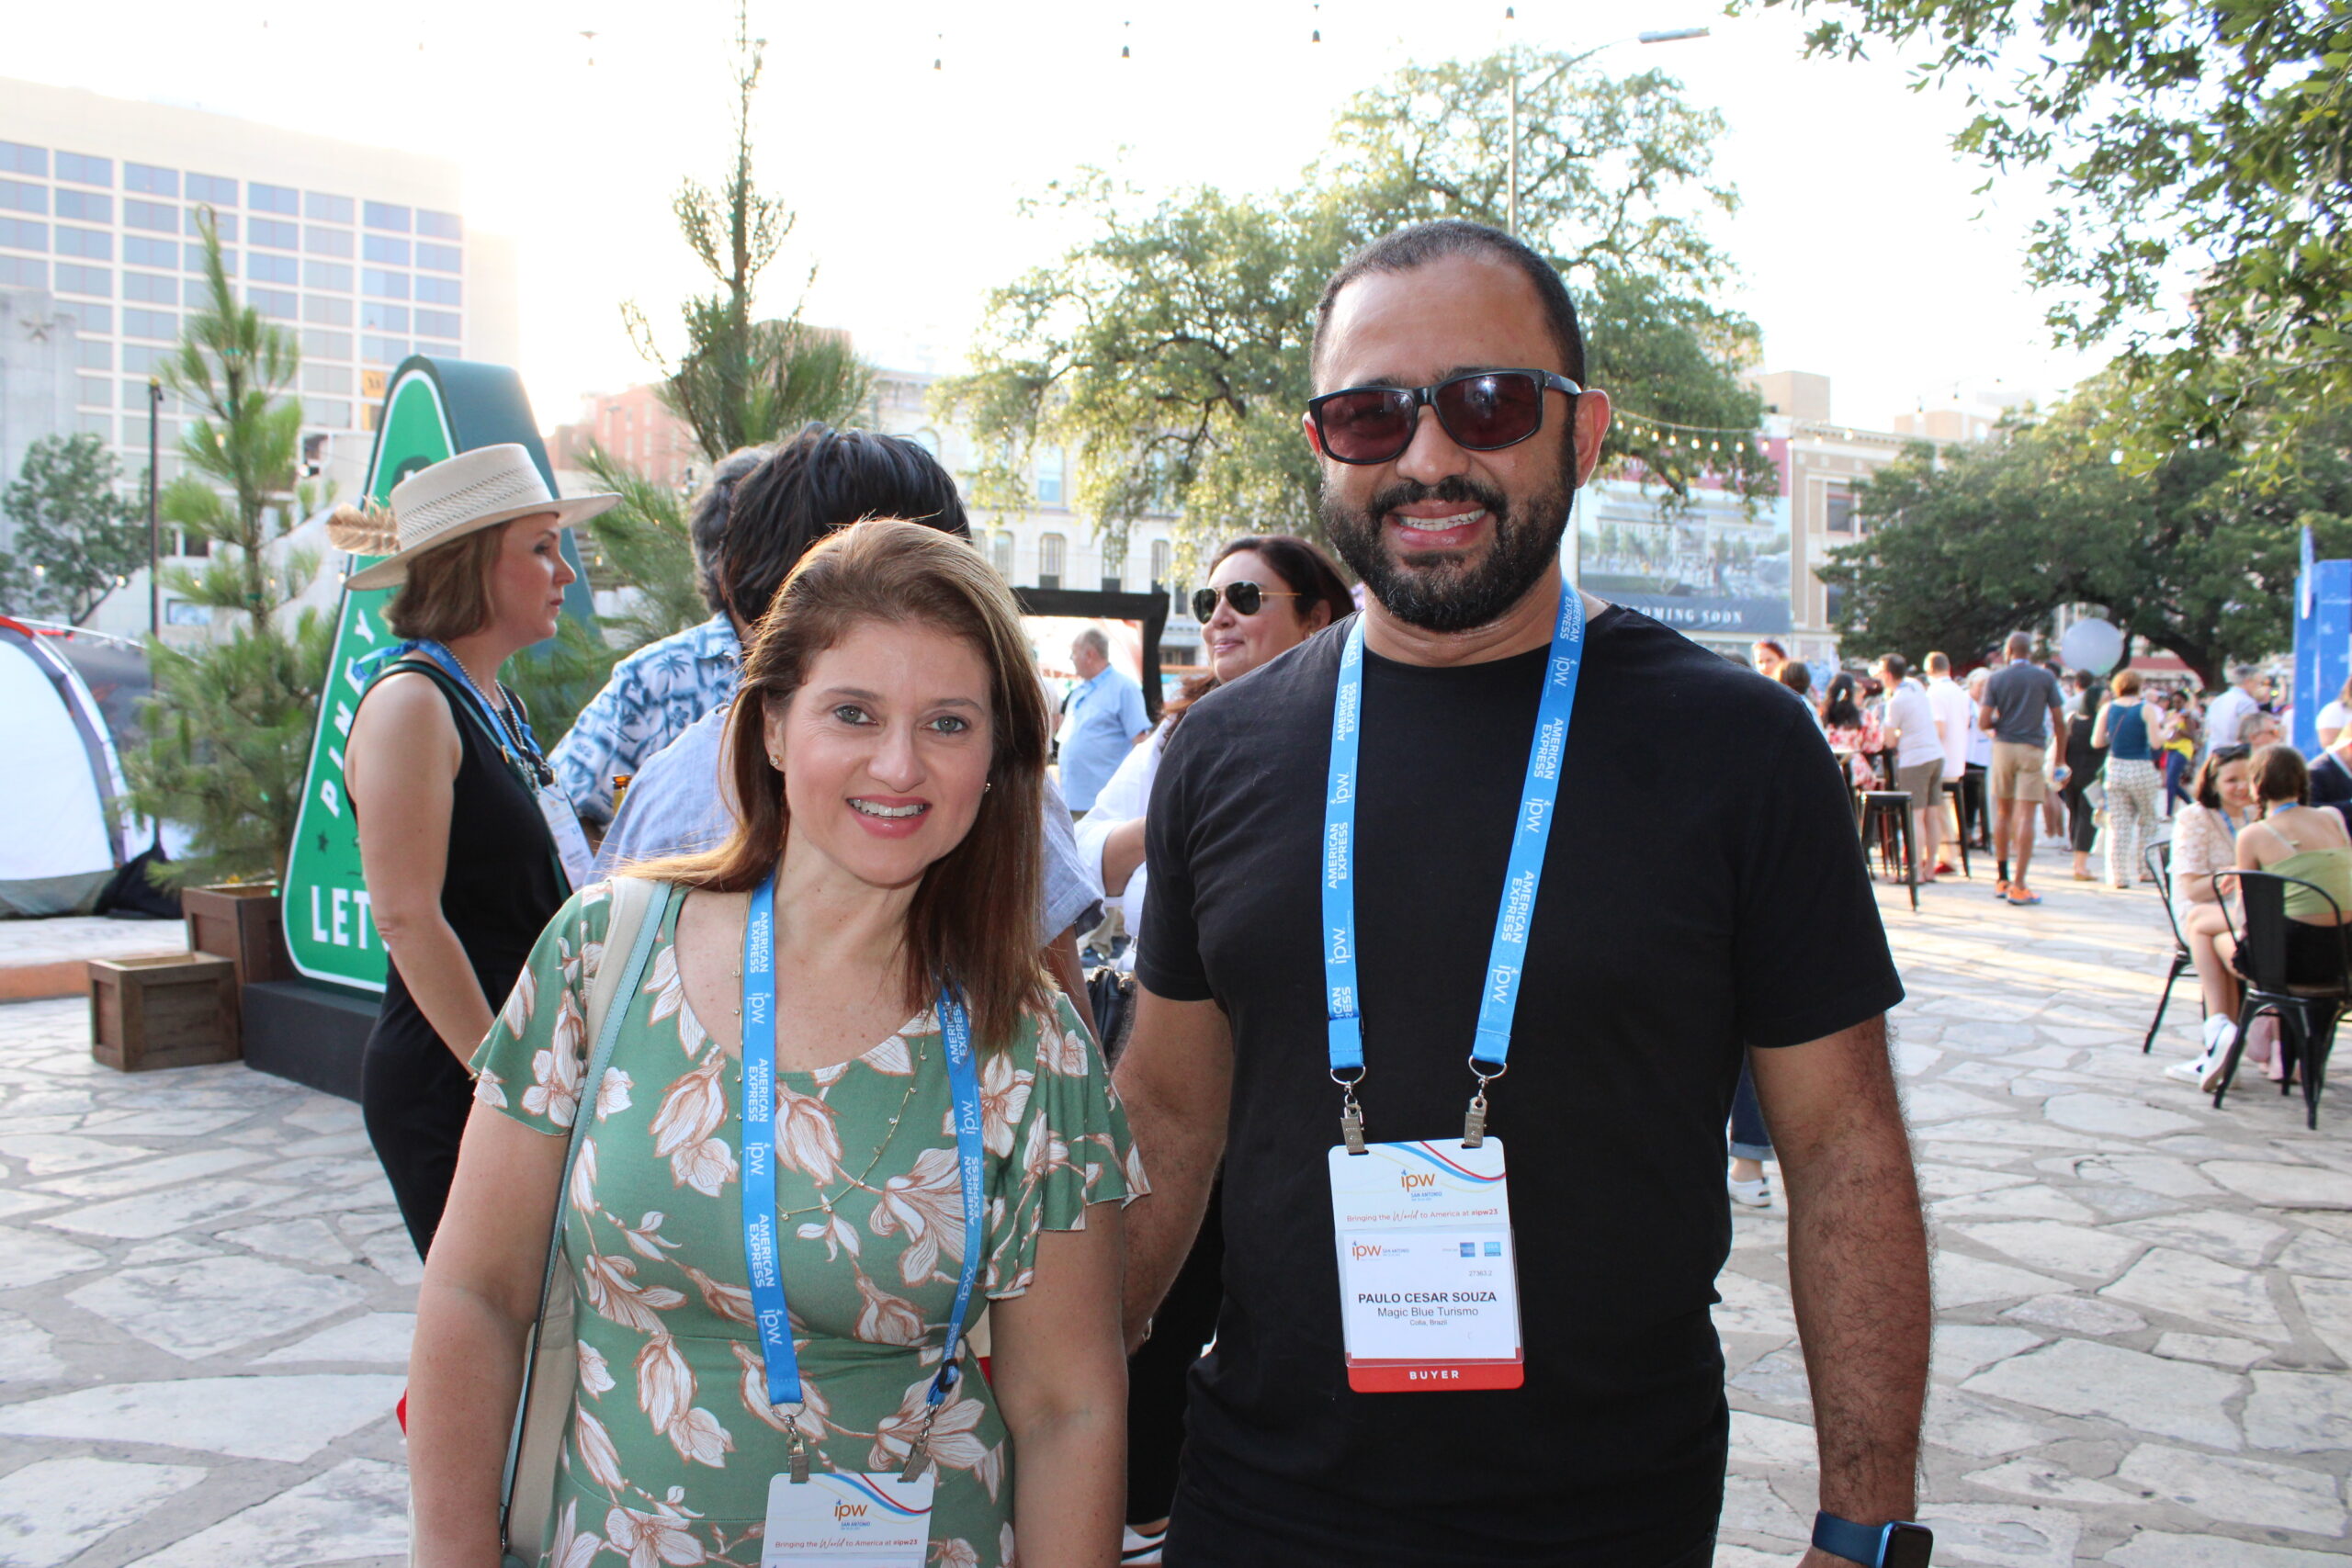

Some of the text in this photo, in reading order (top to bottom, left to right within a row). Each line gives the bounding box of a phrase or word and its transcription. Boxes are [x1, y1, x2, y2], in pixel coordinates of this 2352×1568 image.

[1560, 595, 1573, 640] EXPRESS
[1569, 594, 1581, 643] AMERICAN
[1702, 610, 1743, 625] SOON
[1553, 657, 1577, 687] ipw
[1337, 684, 1350, 741] AMERICAN
[1345, 682, 1358, 733] EXPRESS
[1533, 724, 1553, 779] EXPRESS
[1544, 717, 1564, 780] AMERICAN
[1330, 773, 1352, 805] ipw
[1525, 797, 1552, 833] ipw
[1328, 823, 1339, 889] AMERICAN
[1338, 821, 1349, 880] EXPRESS
[1501, 877, 1522, 942] EXPRESS
[1512, 870, 1534, 943] AMERICAN
[750, 920, 761, 974] EXPRESS
[760, 911, 770, 974] AMERICAN
[1329, 927, 1351, 964] ipw
[1492, 964, 1519, 1004] ipw
[747, 992, 772, 1024] ipw
[748, 1066, 759, 1122] EXPRESS
[758, 1058, 769, 1122] AMERICAN
[960, 1100, 979, 1135] ipw
[746, 1142, 771, 1177] ipw
[964, 1156, 976, 1226] AMERICAN
[972, 1156, 980, 1219] EXPRESS
[1400, 1169, 1436, 1192] ipw
[1347, 1214, 1377, 1224] Bringing
[1379, 1213, 1391, 1221] the
[1430, 1210, 1461, 1219] America
[749, 1224, 765, 1289] EXPRESS
[759, 1213, 775, 1288] AMERICAN
[1352, 1240, 1382, 1261] ipw
[958, 1266, 973, 1301] ipw
[1358, 1292, 1498, 1304] PAULO CESAR SOUZA
[759, 1309, 784, 1346] ipw
[1377, 1306, 1479, 1319] Magic Blue Turismo
[1408, 1370, 1460, 1381] BUYER
[834, 1499, 868, 1522] ipw
[855, 1540, 883, 1548] America
